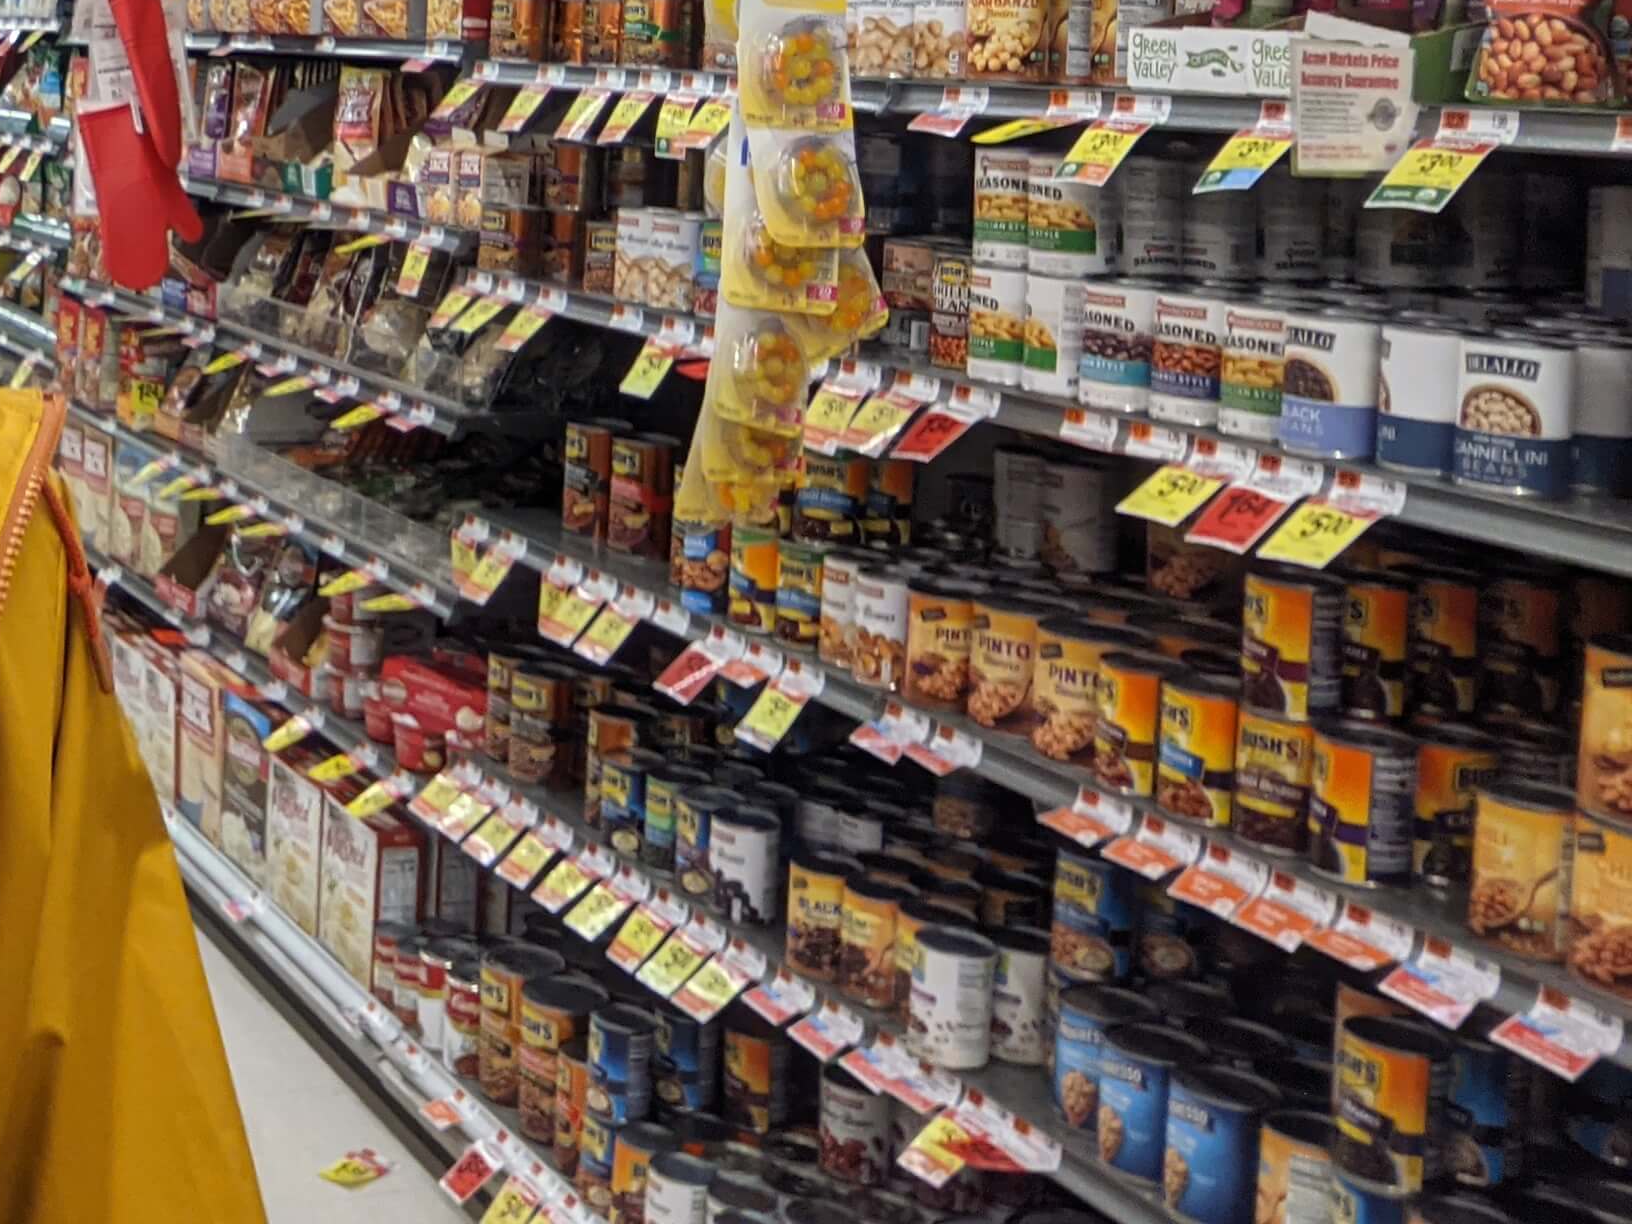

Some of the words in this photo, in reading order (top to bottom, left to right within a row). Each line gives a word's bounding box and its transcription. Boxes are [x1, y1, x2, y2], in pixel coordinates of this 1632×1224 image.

[1370, 53, 1400, 69] Price
[935, 627, 972, 643] PINT
[978, 634, 1031, 660] PINTO
